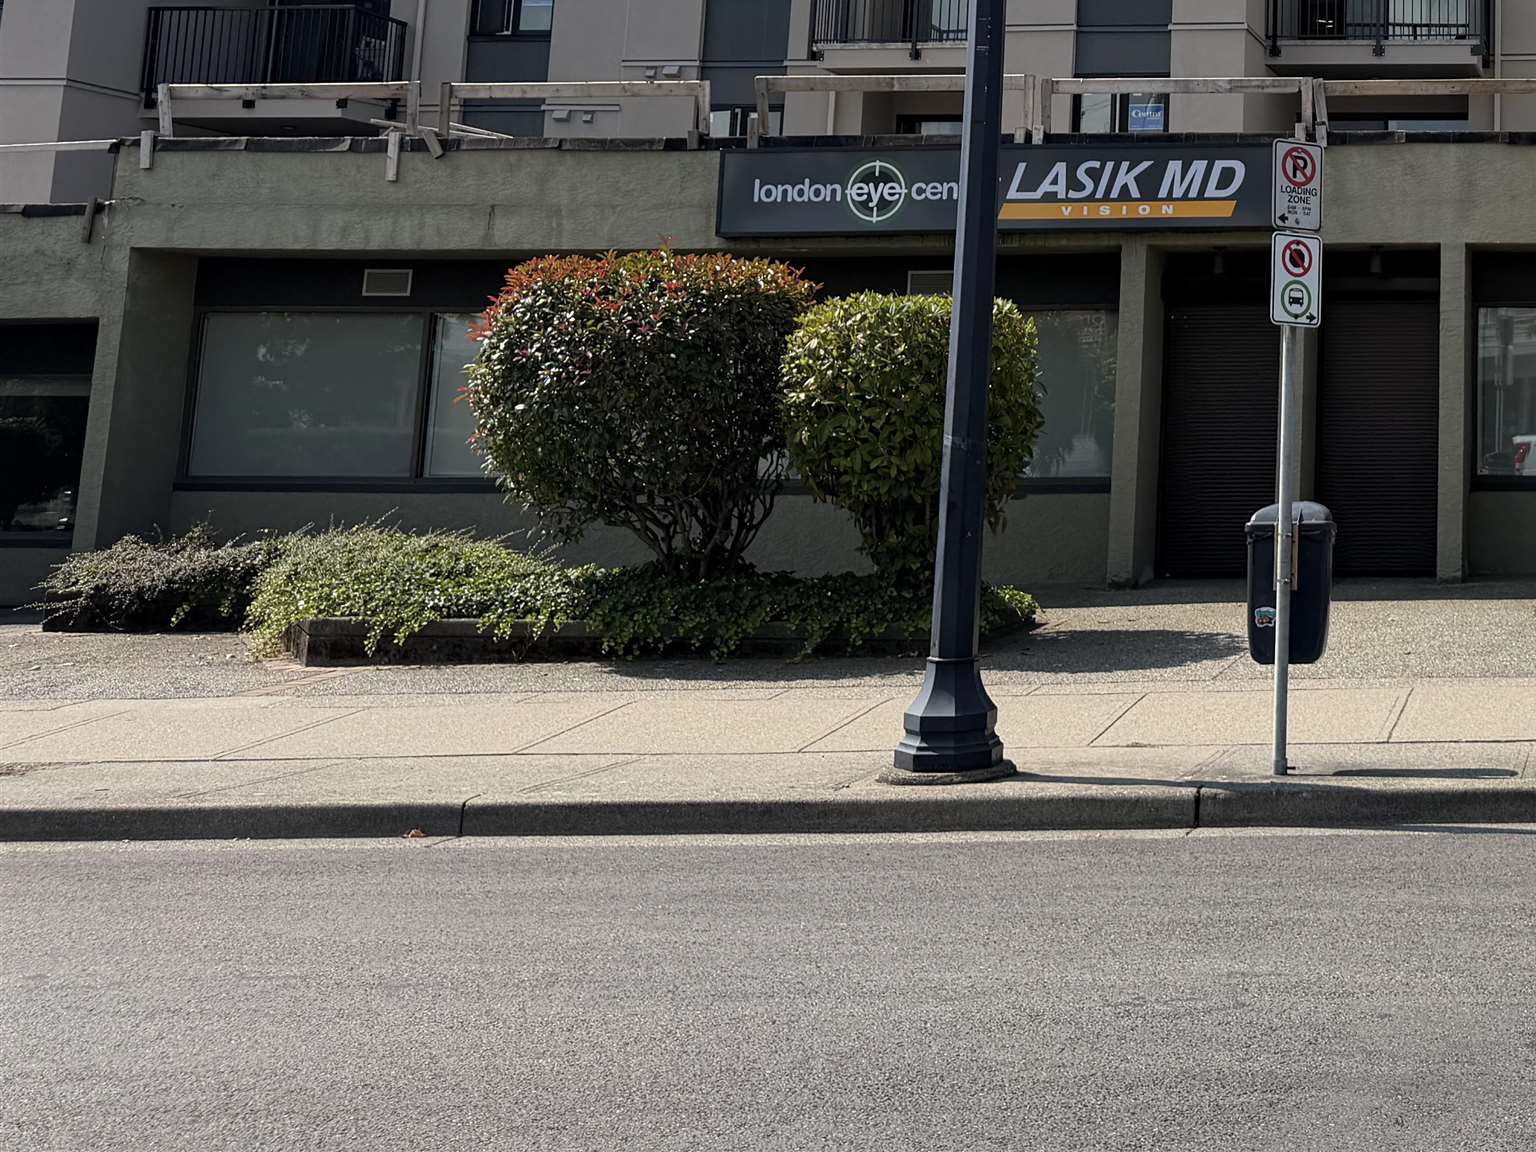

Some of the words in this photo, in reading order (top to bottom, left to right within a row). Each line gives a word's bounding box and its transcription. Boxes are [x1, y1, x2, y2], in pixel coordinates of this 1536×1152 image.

[1006, 160, 1155, 200] LASIK
[1158, 159, 1246, 199] MD
[753, 178, 842, 202] london
[851, 181, 900, 207] eye
[911, 181, 960, 200] cen
[1280, 185, 1318, 197] LOADING
[1287, 194, 1311, 205] ZONE
[1060, 205, 1174, 216] VISION
